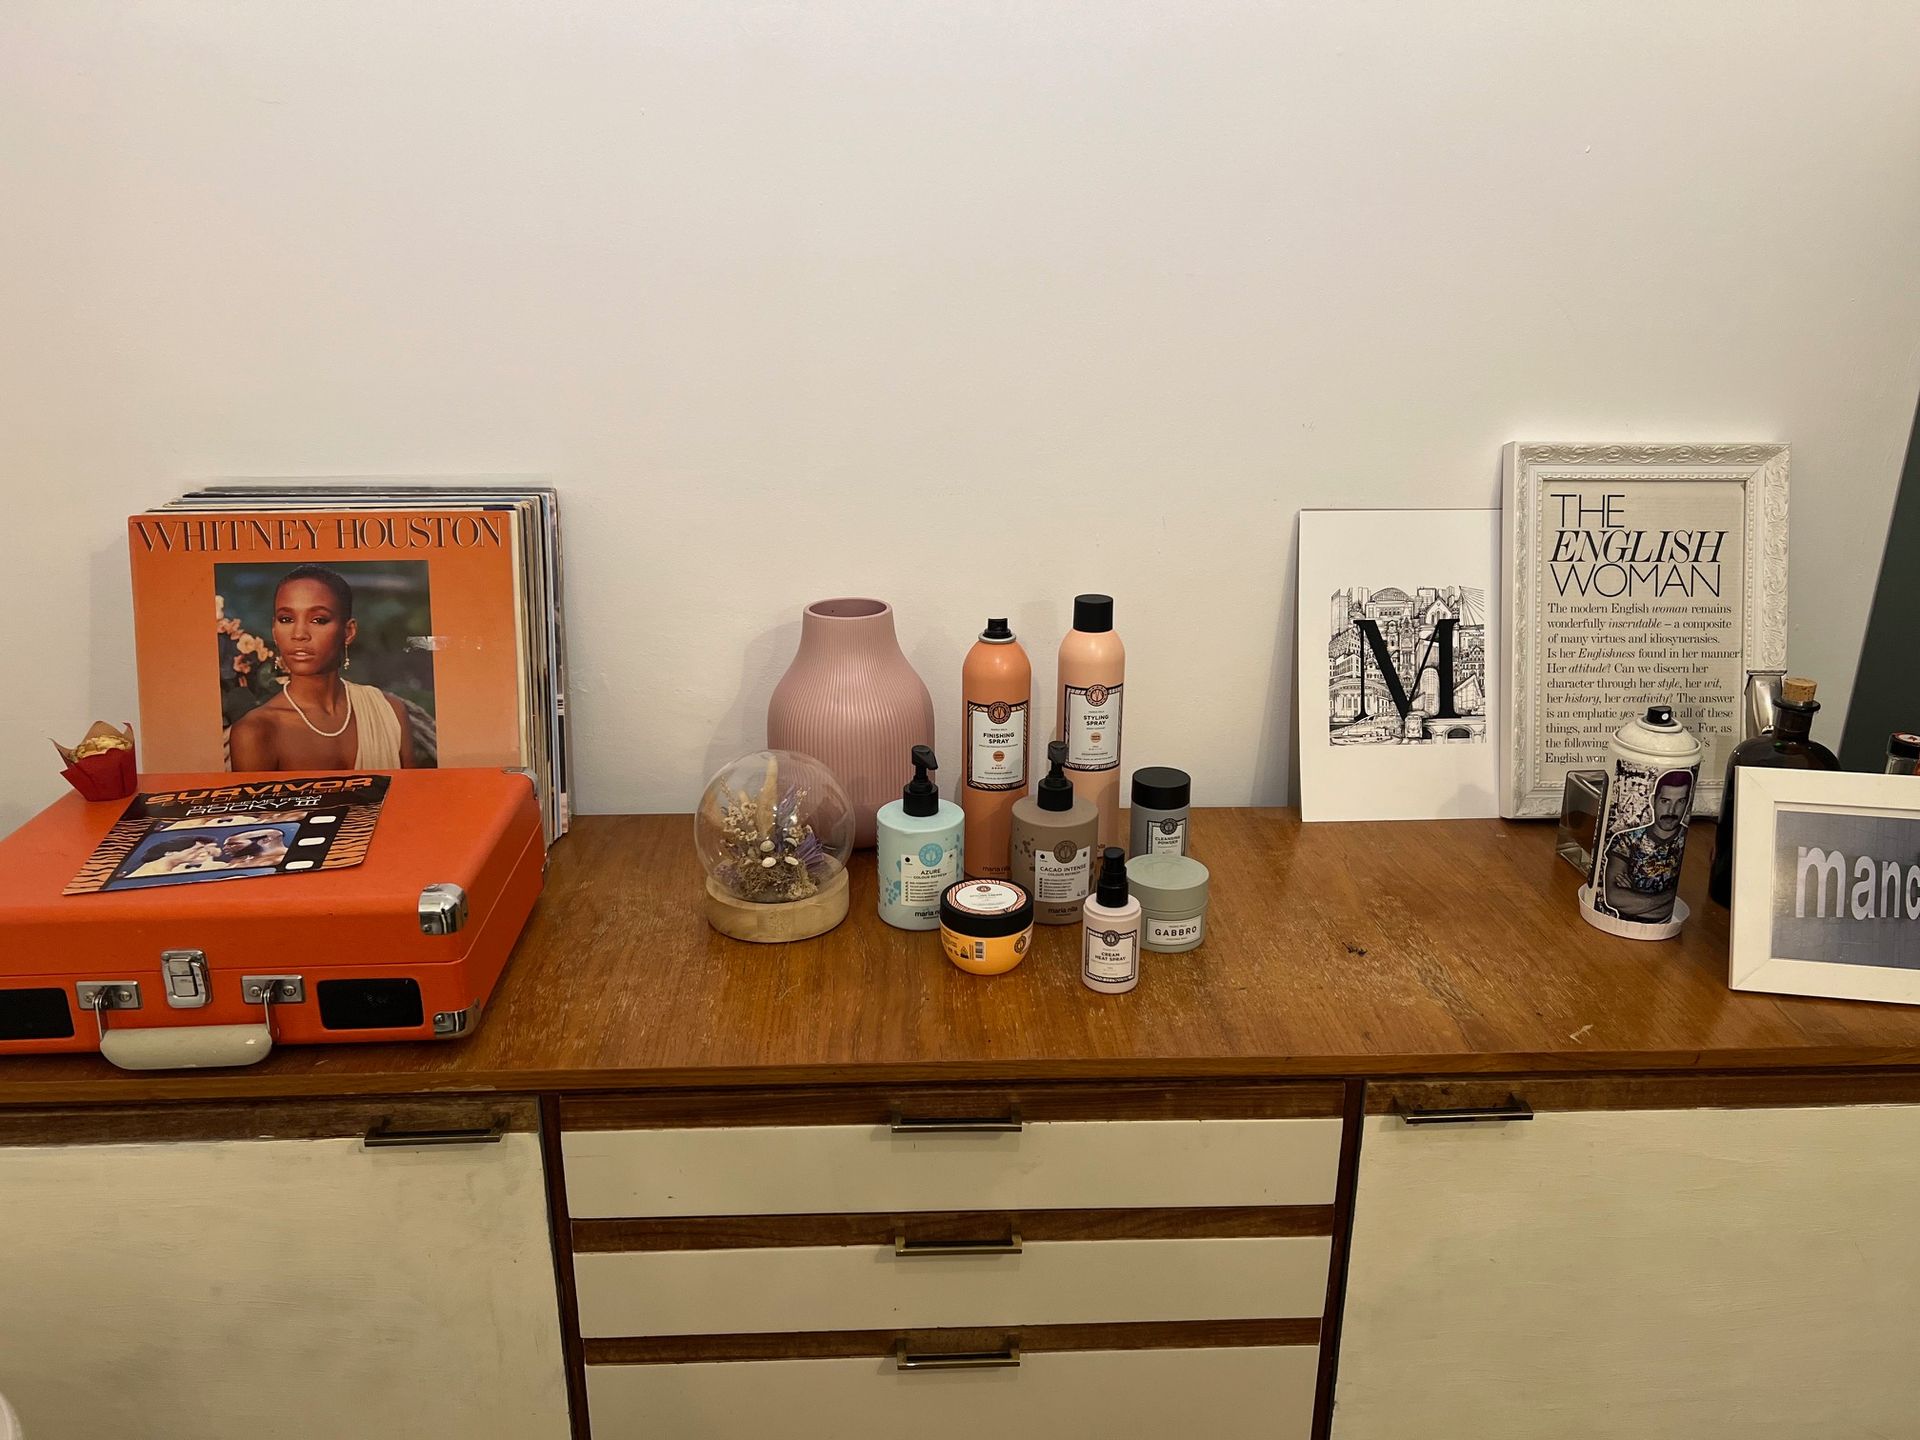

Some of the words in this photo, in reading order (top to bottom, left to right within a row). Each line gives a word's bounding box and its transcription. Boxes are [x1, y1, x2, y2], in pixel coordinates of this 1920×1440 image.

[1550, 494, 1625, 528] THE
[130, 519, 328, 552] WHITNEY
[336, 517, 501, 549] HOUSTON
[1548, 530, 1729, 563] ENGLISH
[1550, 563, 1720, 597] WOMAN
[1548, 603, 1567, 613] The
[1571, 603, 1608, 613] modern
[1611, 603, 1649, 616] English
[1691, 603, 1731, 613] remains
[1547, 618, 1606, 631] wonderfully
[1608, 618, 1661, 628] inscrutable
[1683, 618, 1731, 631] composite
[1548, 633, 1558, 643] of
[1560, 636, 1588, 646] many
[1591, 633, 1625, 643] virtues
[1628, 633, 1647, 643] and
[1650, 633, 1720, 646] idiosyncrasies.
[1547, 648, 1557, 658] Is
[1560, 648, 1576, 658] her
[1579, 648, 1635, 661] Englishness
[1638, 648, 1666, 658] found
[1670, 648, 1679, 658] in
[1682, 648, 1698, 658] her
[1353, 619, 1460, 720] M
[1547, 663, 1566, 673] Her
[1569, 663, 1611, 673] attitude?
[1614, 663, 1634, 673] Can
[1654, 663, 1689, 673] discern
[1692, 663, 1708, 673] her
[1547, 679, 1594, 689] character
[1597, 679, 1636, 692] through
[1640, 679, 1656, 689] her
[1658, 679, 1682, 692] style,
[1685, 679, 1702, 689] her
[1704, 679, 1722, 690] wit,
[1547, 693, 1564, 703] her
[1565, 693, 1601, 706] history,
[1605, 693, 1621, 703] her
[1623, 693, 1673, 706] creativity?
[1677, 693, 1696, 703] The
[1547, 708, 1554, 718] is
[1572, 708, 1617, 721] emphatic
[1620, 711, 1634, 721] yes
[1681, 708, 1692, 718] all
[1695, 708, 1704, 718] of
[1707, 708, 1733, 718] these
[1546, 723, 1580, 735] things,
[1583, 723, 1601, 732] and
[1699, 723, 1717, 734] For,
[1546, 738, 1561, 748] the
[1565, 738, 1609, 751] following
[1545, 753, 1583, 766] English
[145, 778, 372, 804] SURVIVOR
[186, 801, 288, 816] ROCKY
[1064, 864, 1086, 872] INTENSE
[1155, 926, 1197, 936] GABBRO
